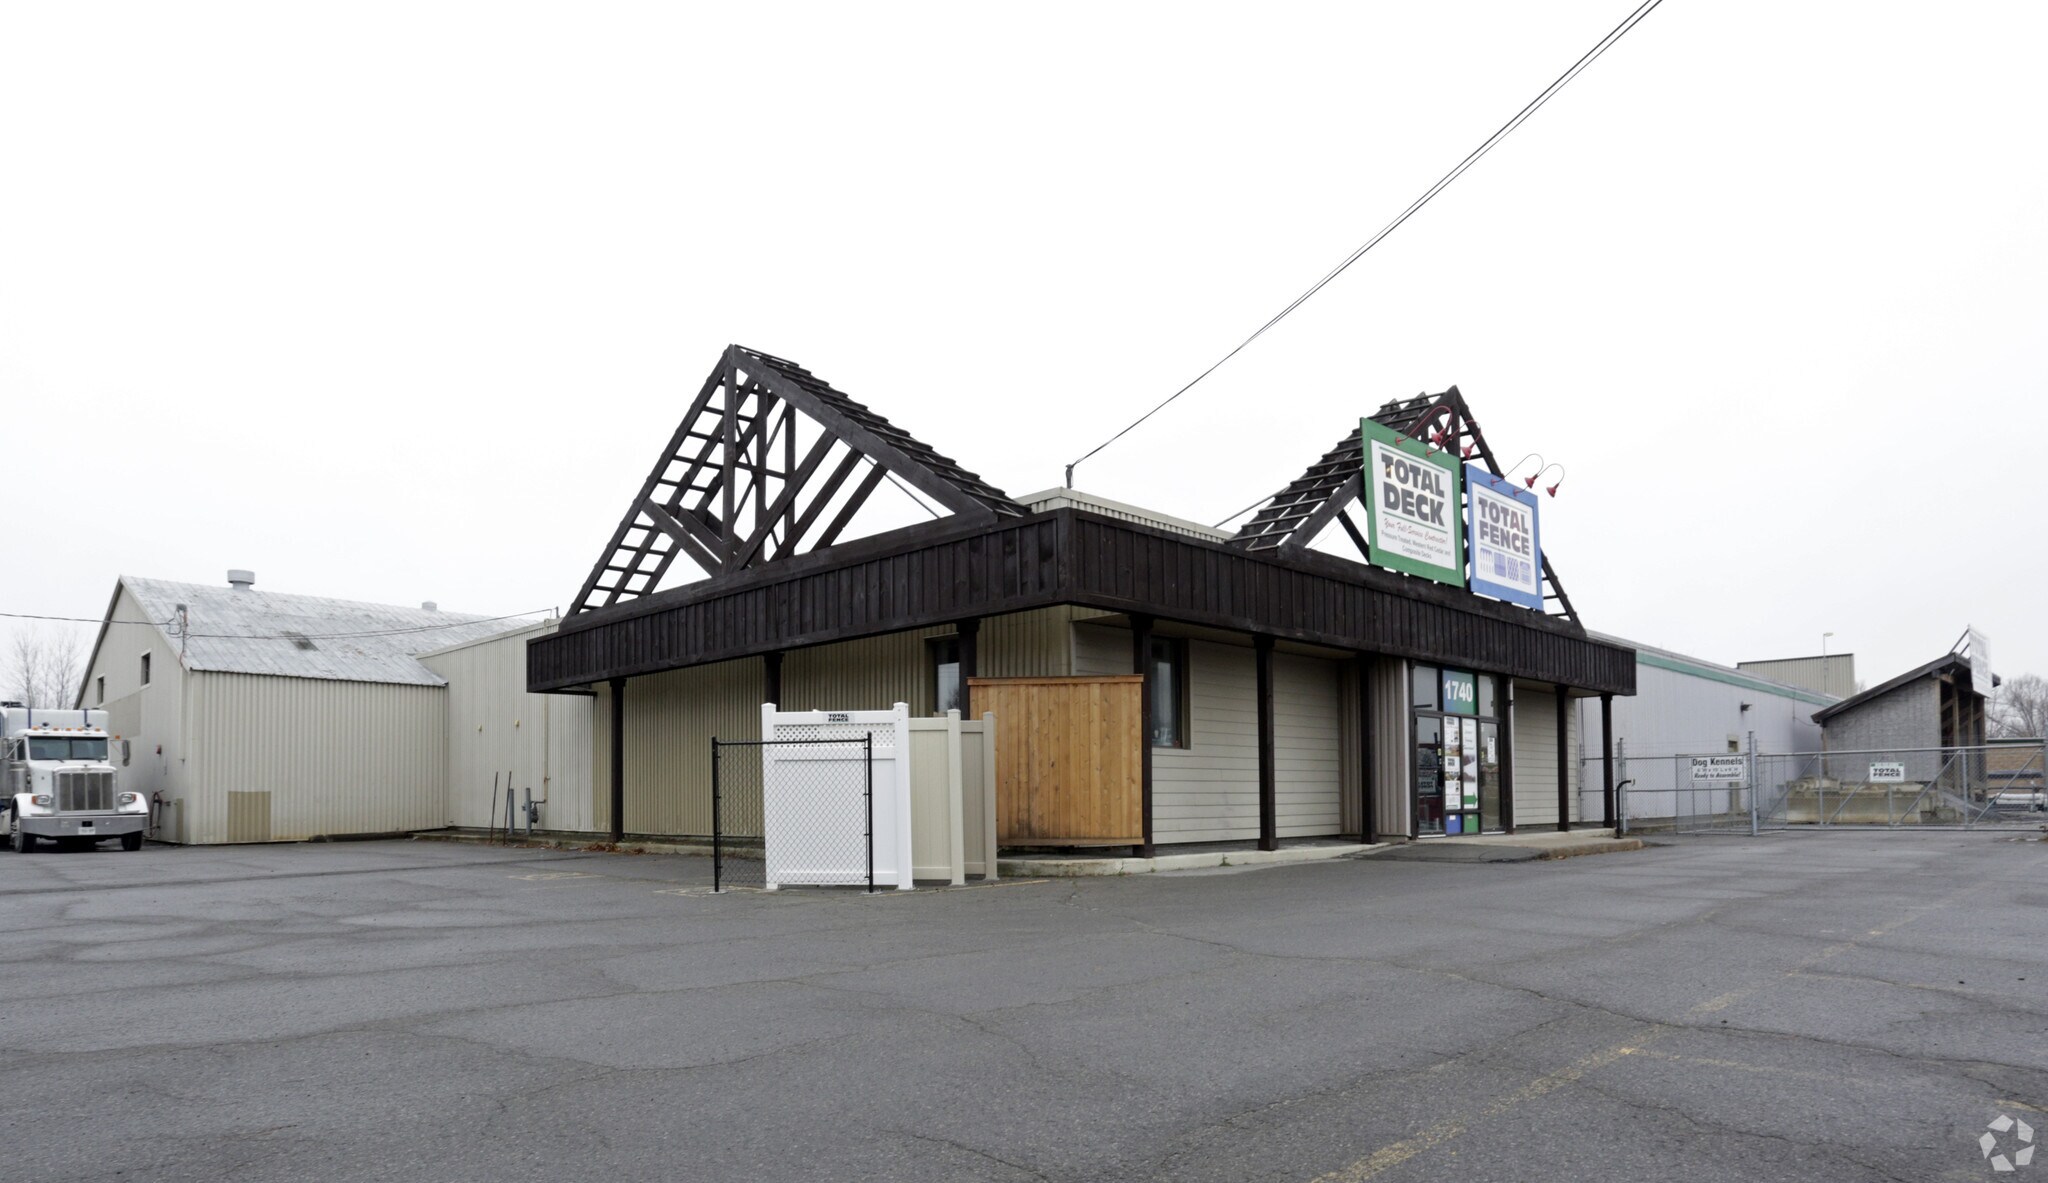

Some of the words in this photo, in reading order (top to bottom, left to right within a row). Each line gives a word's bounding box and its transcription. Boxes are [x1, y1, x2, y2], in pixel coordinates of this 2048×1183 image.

[1381, 452, 1445, 499] TOTAL
[1383, 481, 1445, 527] DECK
[1478, 496, 1529, 535] TOTAL
[1479, 519, 1530, 556] FENCE
[1445, 679, 1473, 703] 1740
[1692, 758, 1707, 767] Dog
[1710, 757, 1744, 766] Kennels
